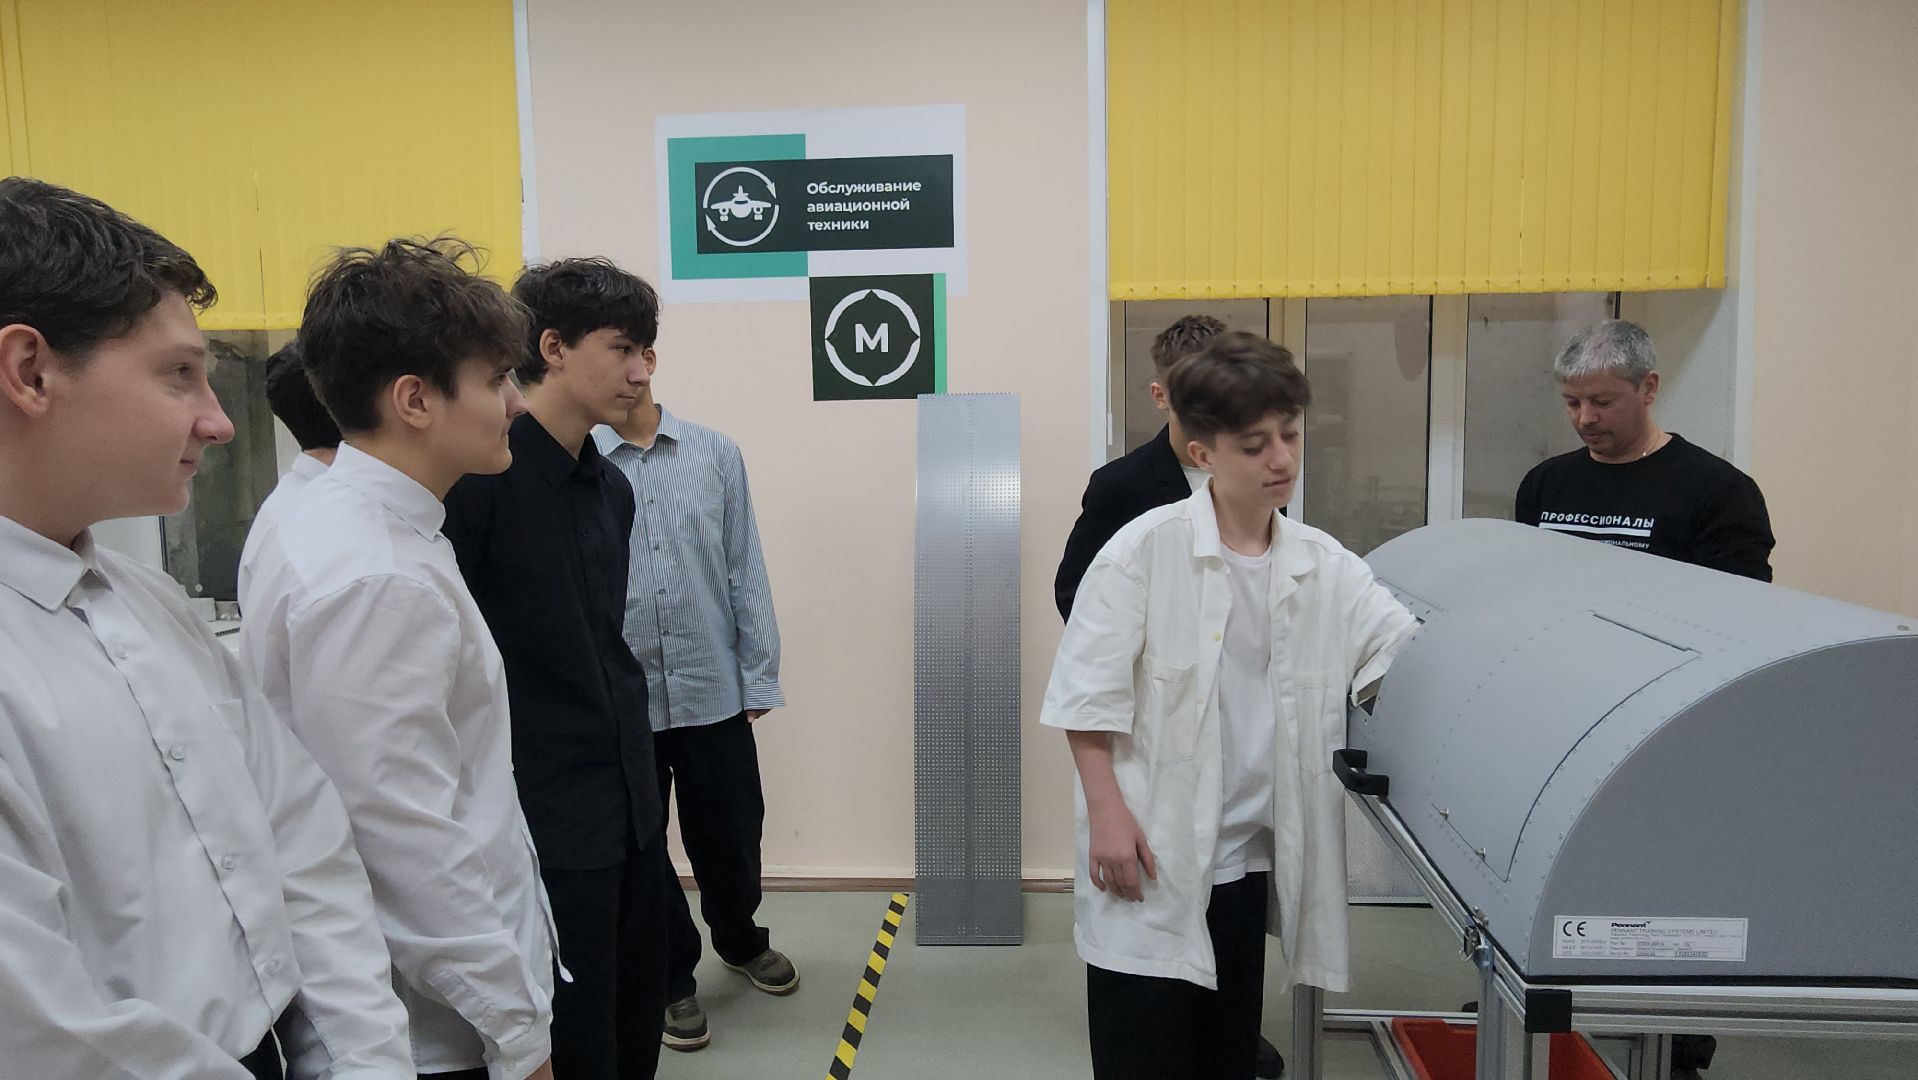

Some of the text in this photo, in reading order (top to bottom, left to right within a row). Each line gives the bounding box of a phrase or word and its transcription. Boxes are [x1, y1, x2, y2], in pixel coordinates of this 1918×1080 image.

[806, 181, 922, 196] Обслуживание
[806, 198, 910, 213] авиационной
[807, 220, 870, 231] техники
[1540, 511, 1655, 528] ПРОФЕССИОНАЛЫ
[1562, 920, 1587, 937] CE
